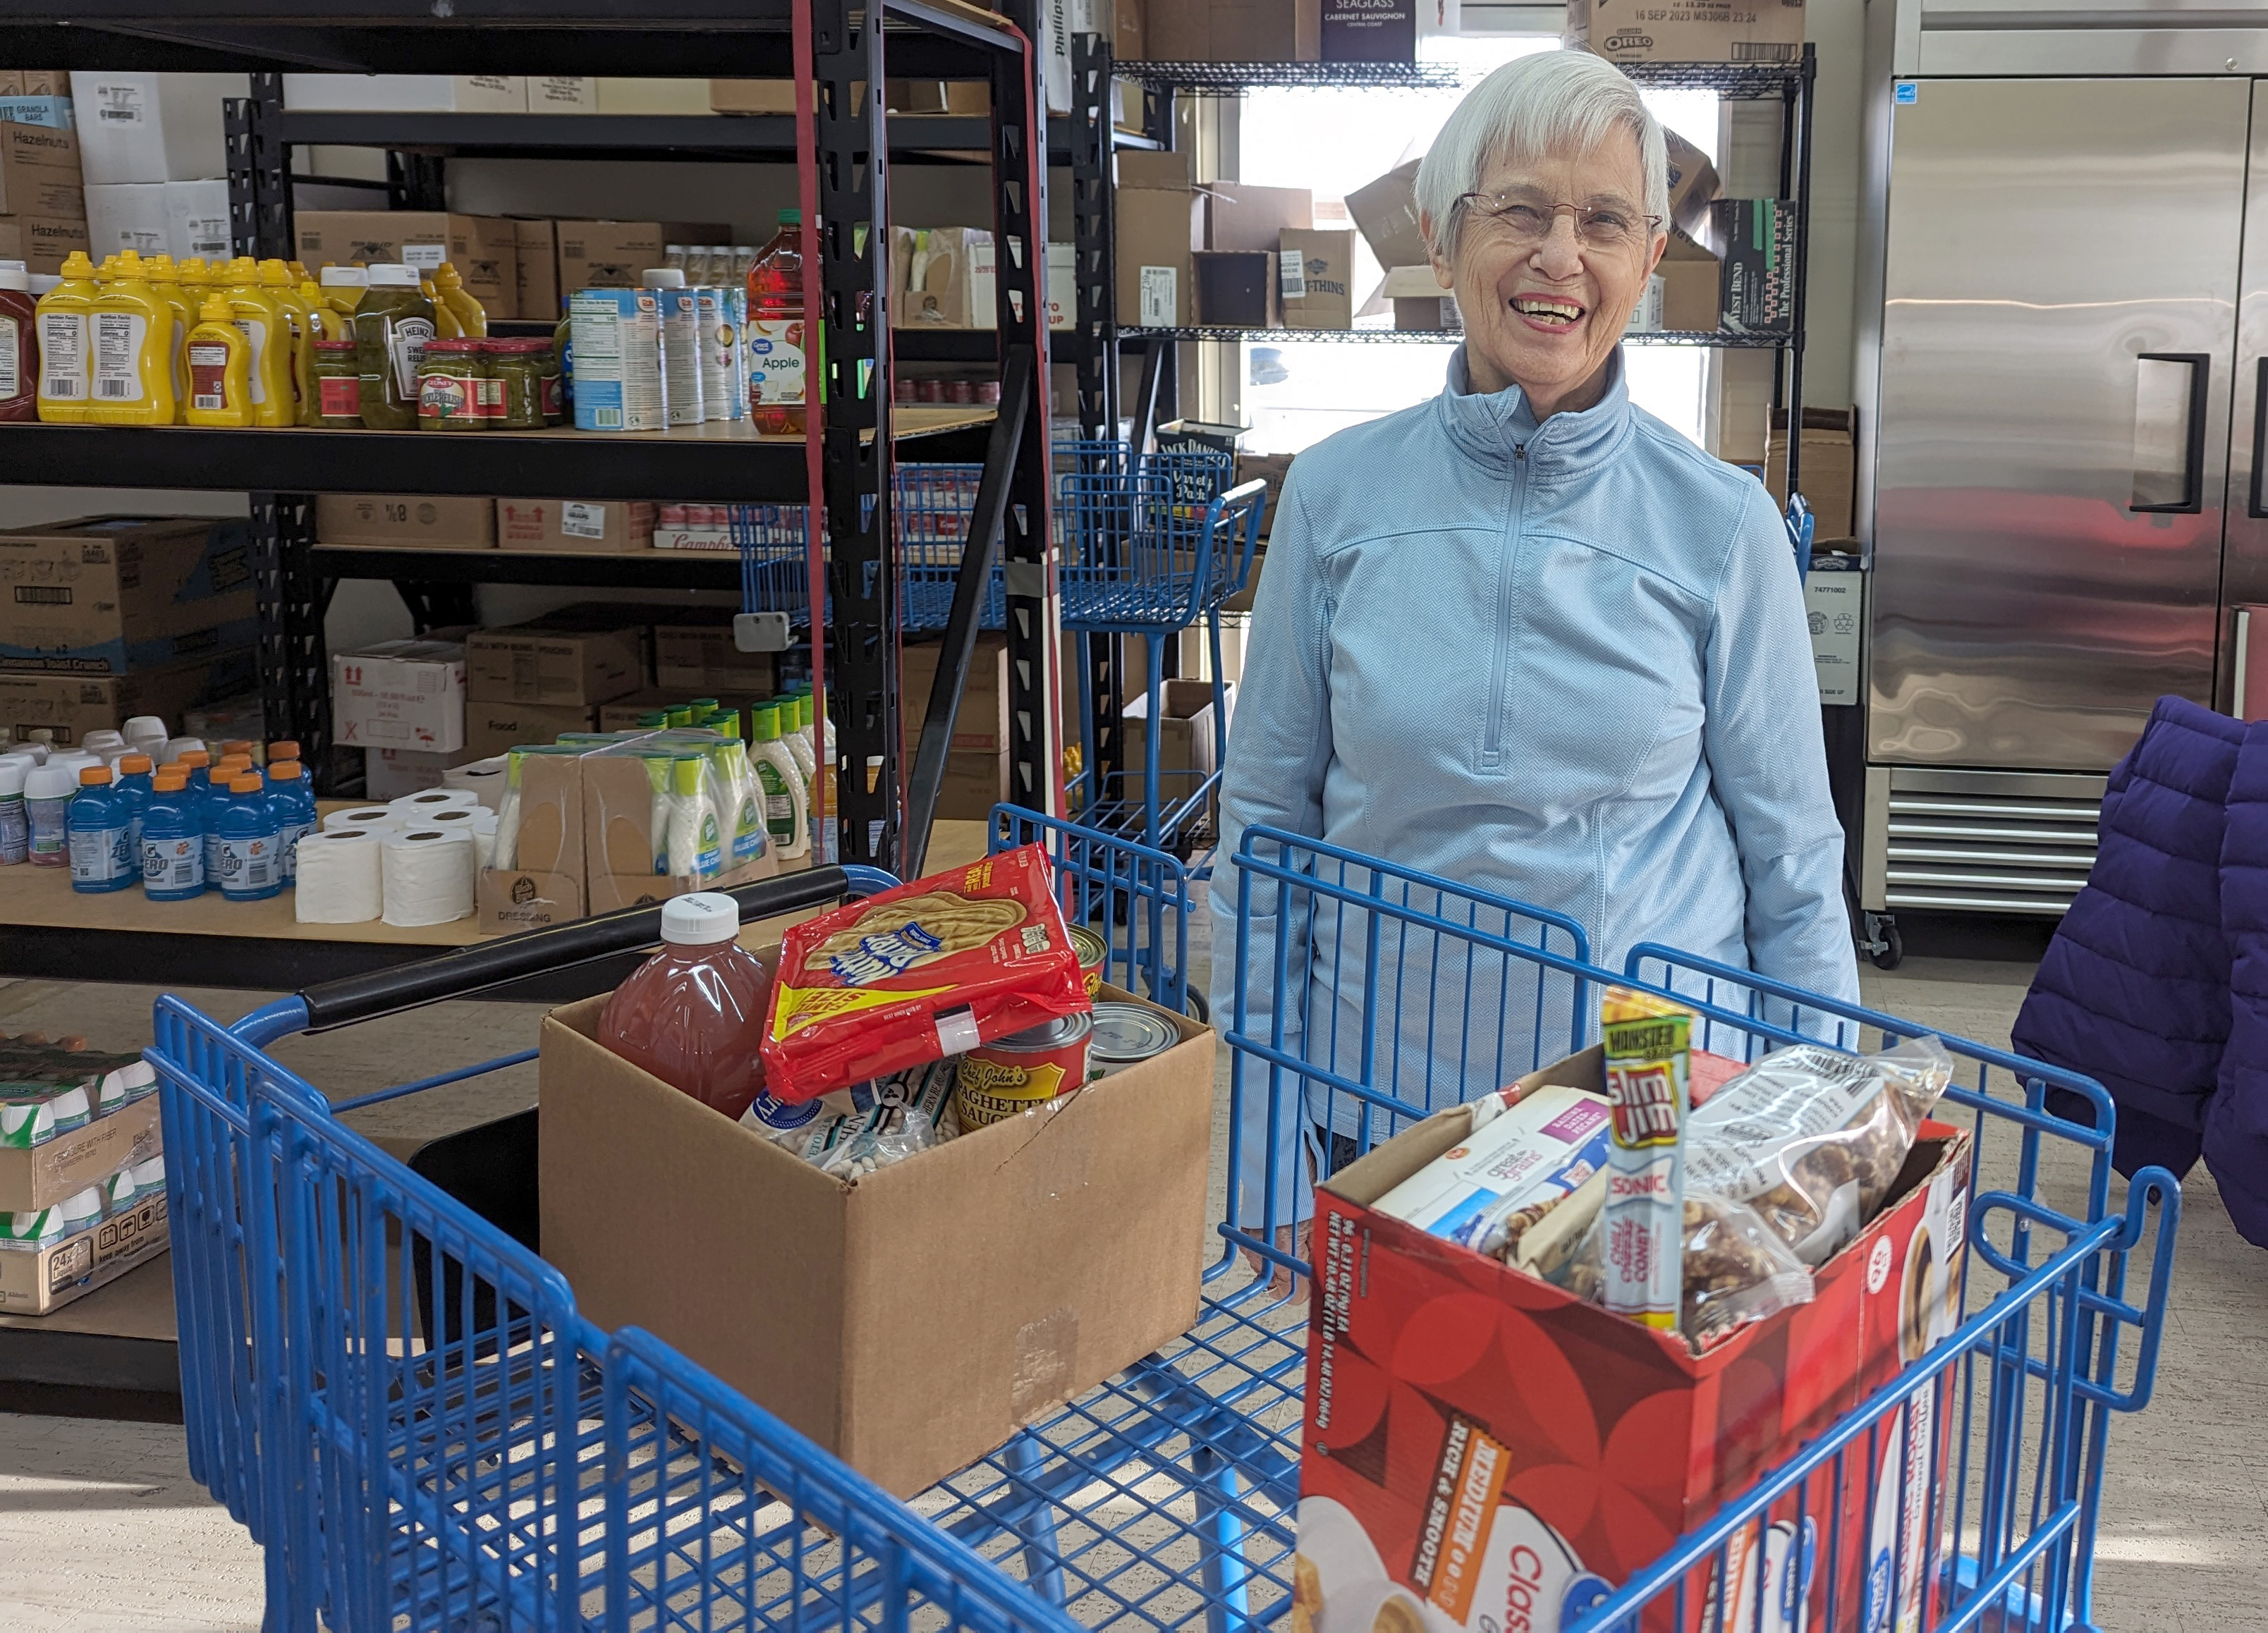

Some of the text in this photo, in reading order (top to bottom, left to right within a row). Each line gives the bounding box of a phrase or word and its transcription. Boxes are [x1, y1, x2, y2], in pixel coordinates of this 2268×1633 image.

[1635, 11, 1645, 20] 16
[1648, 11, 1667, 20] SEP
[1669, 11, 1690, 21] 2023
[1604, 36, 1653, 51] OREO
[16, 105, 49, 114] GRANOLA
[1779, 214, 1793, 318] The Professional Series
[1731, 262, 1743, 292] BEND
[1305, 280, 1345, 295] T-THINS
[405, 326, 429, 338] HEINZ
[407, 345, 424, 355] SWE
[762, 357, 800, 371] Apple
[1160, 443, 1186, 460] JACK
[488, 720, 518, 731] Food
[221, 858, 243, 871] ERO
[1610, 1025, 1675, 1053] MONSTER
[961, 1061, 1025, 1087] Chef John's
[958, 1080, 1046, 1113] PAGHETT
[961, 1101, 1009, 1126] SAUC
[1611, 1175, 1666, 1194] SONIC
[1328, 1210, 1341, 1235] NET
[1342, 1218, 1355, 1237] 96
[1327, 1235, 1340, 1259] WT
[1634, 1223, 1650, 1283] CONEY
[1340, 1243, 1353, 1271] 0.31
[1325, 1256, 1339, 1292] 30.48
[1339, 1271, 1352, 1290] OZ
[1324, 1292, 1337, 1309] OZ
[1322, 1323, 1336, 1342] LB
[1336, 1316, 1350, 1333] EA
[1320, 1343, 1334, 1378] 14.48
[1414, 1419, 1470, 1587] RICH & SMOOTH
[1451, 1438, 1500, 1554] MEDIUM
[1504, 1544, 1544, 1633] Clas
